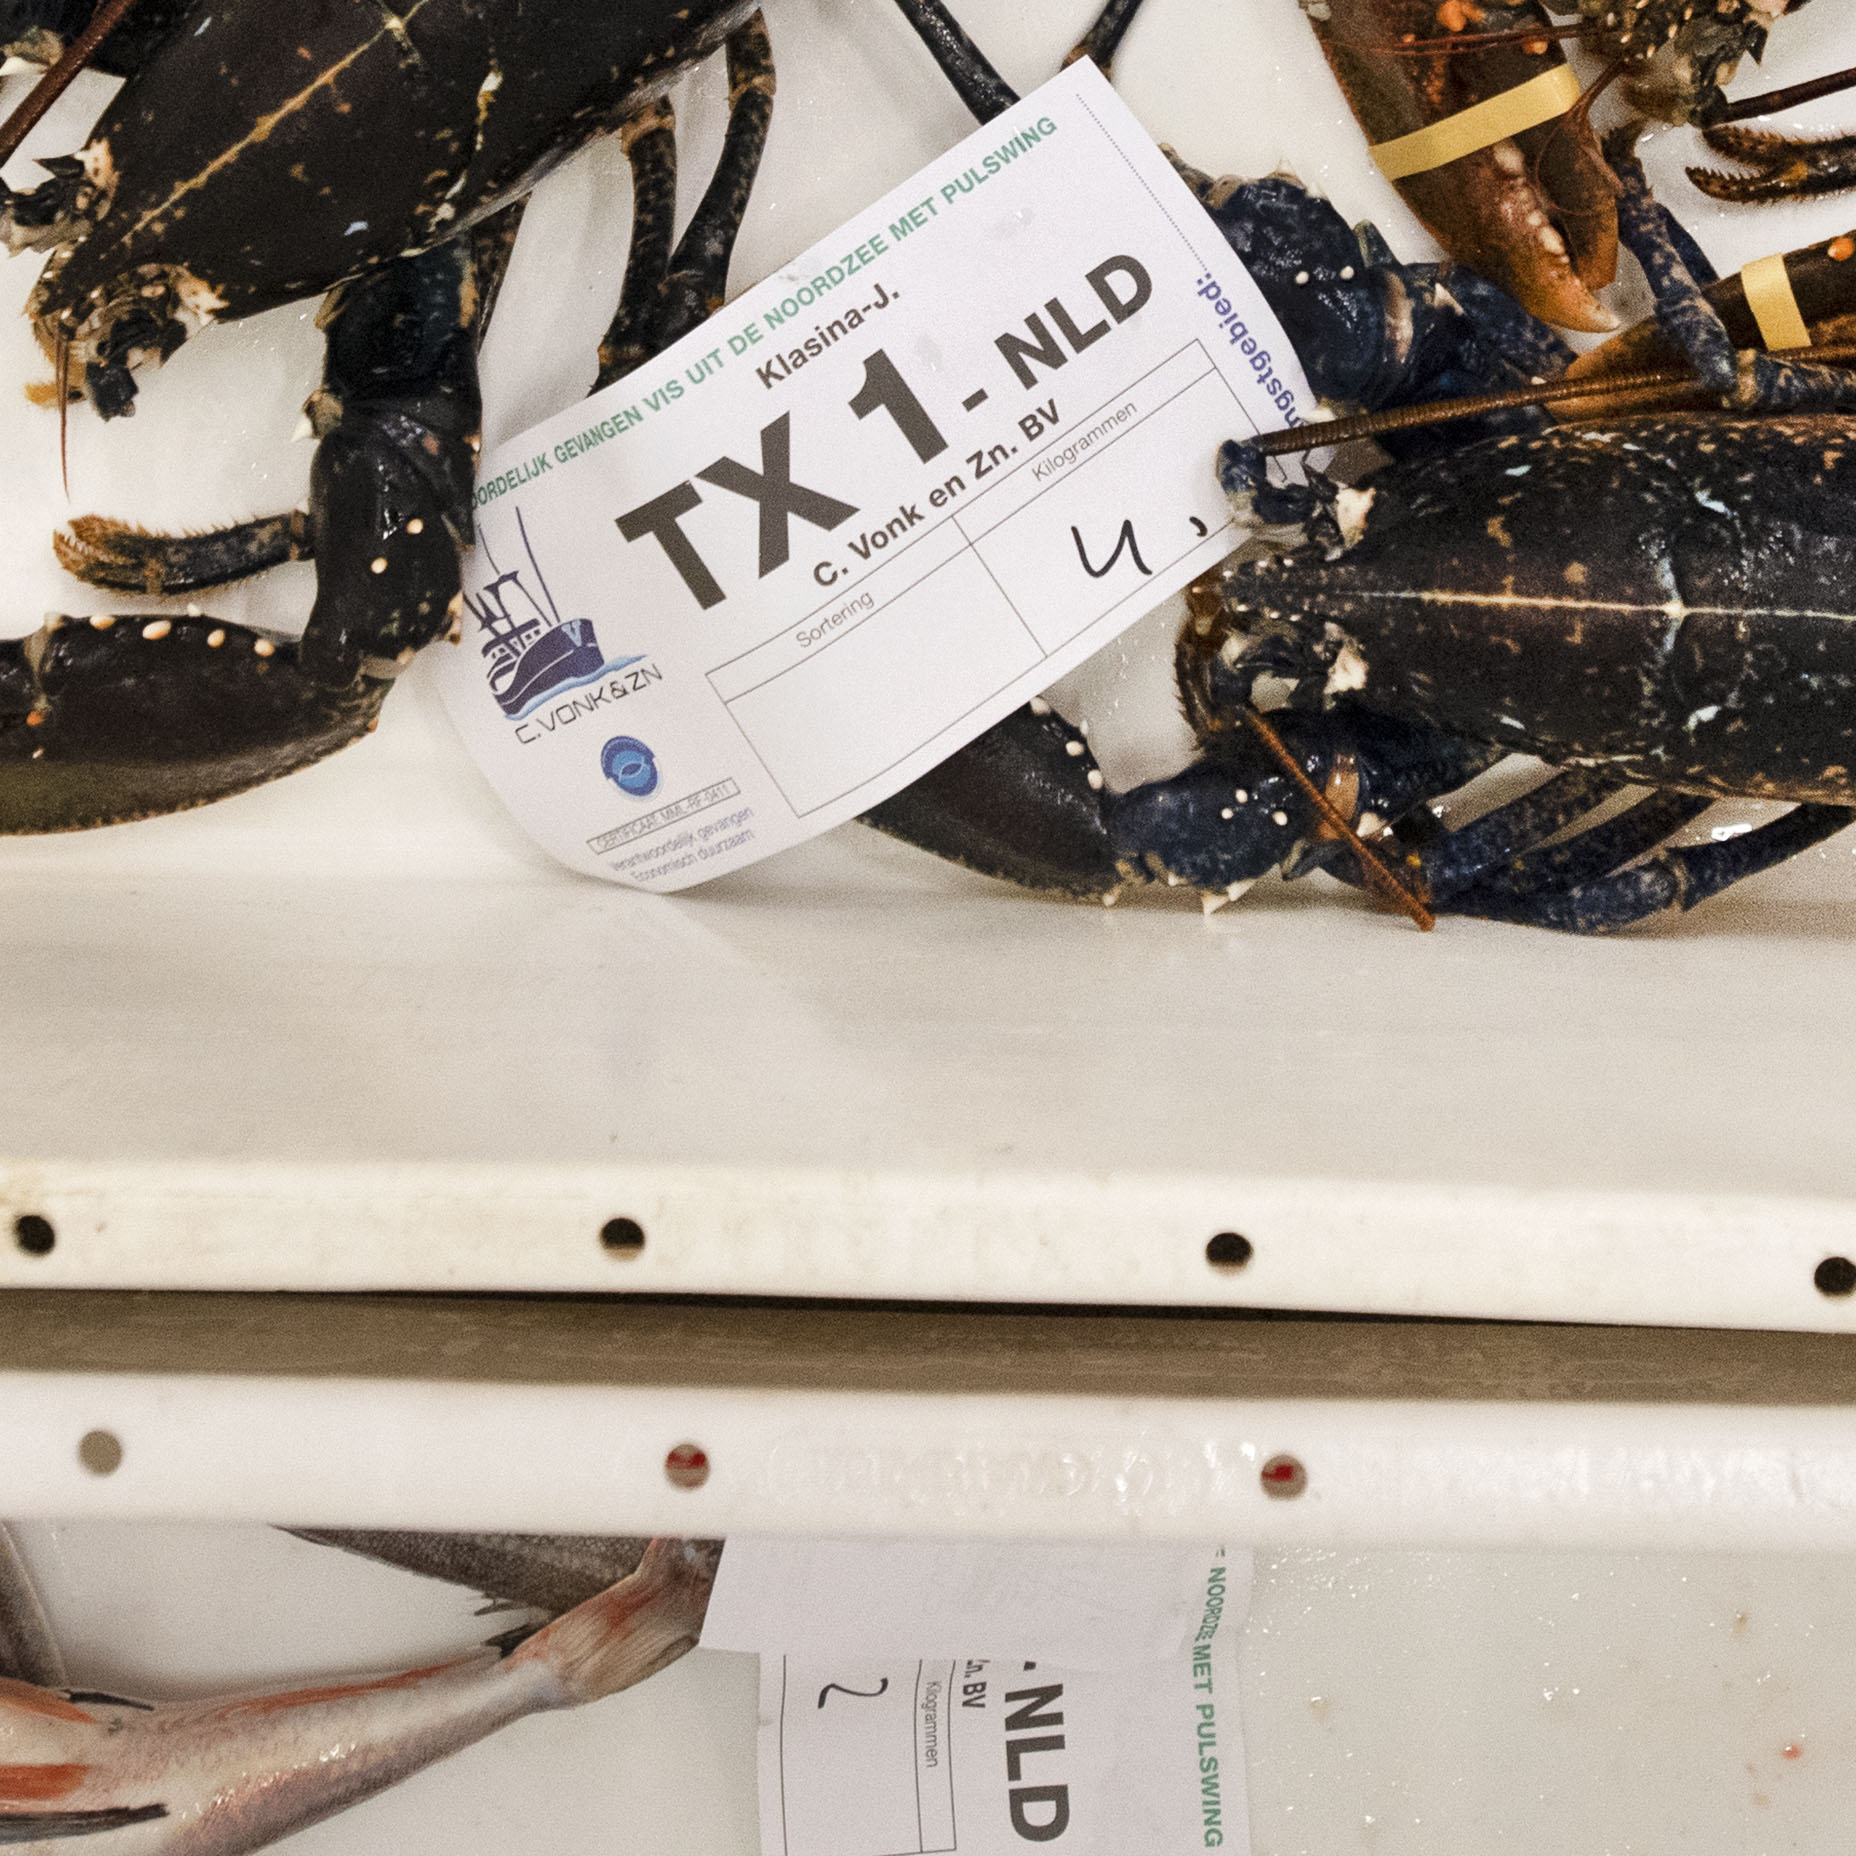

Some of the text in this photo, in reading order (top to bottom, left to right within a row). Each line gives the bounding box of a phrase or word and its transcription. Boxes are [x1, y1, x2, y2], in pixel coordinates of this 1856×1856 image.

[555, 406, 643, 463] GEVANGEN
[643, 380, 685, 413] VIS
[685, 348, 725, 384] UIT
[727, 322, 764, 356] DE
[763, 234, 889, 330] NOORDZEE
[889, 196, 939, 242] MET
[940, 116, 1058, 204] PULSWING
[755, 283, 900, 390] Klasina-J.
[614, 410, 861, 611] TX
[848, 348, 949, 465] 1
[994, 254, 1153, 391] NLD
[1032, 401, 1138, 482] Kilogrammen
[812, 398, 1061, 587] C. Vonk en Zn. BV
[796, 592, 875, 648] Sortering
[515, 663, 664, 744] C.VONK&ZN
[961, 1681, 987, 1709] BV
[1193, 1643, 1213, 1695] MET
[920, 1681, 942, 1769] Kilogrammen
[1005, 1683, 1070, 1842] NLD
[1196, 1703, 1223, 1848] PULSWING
